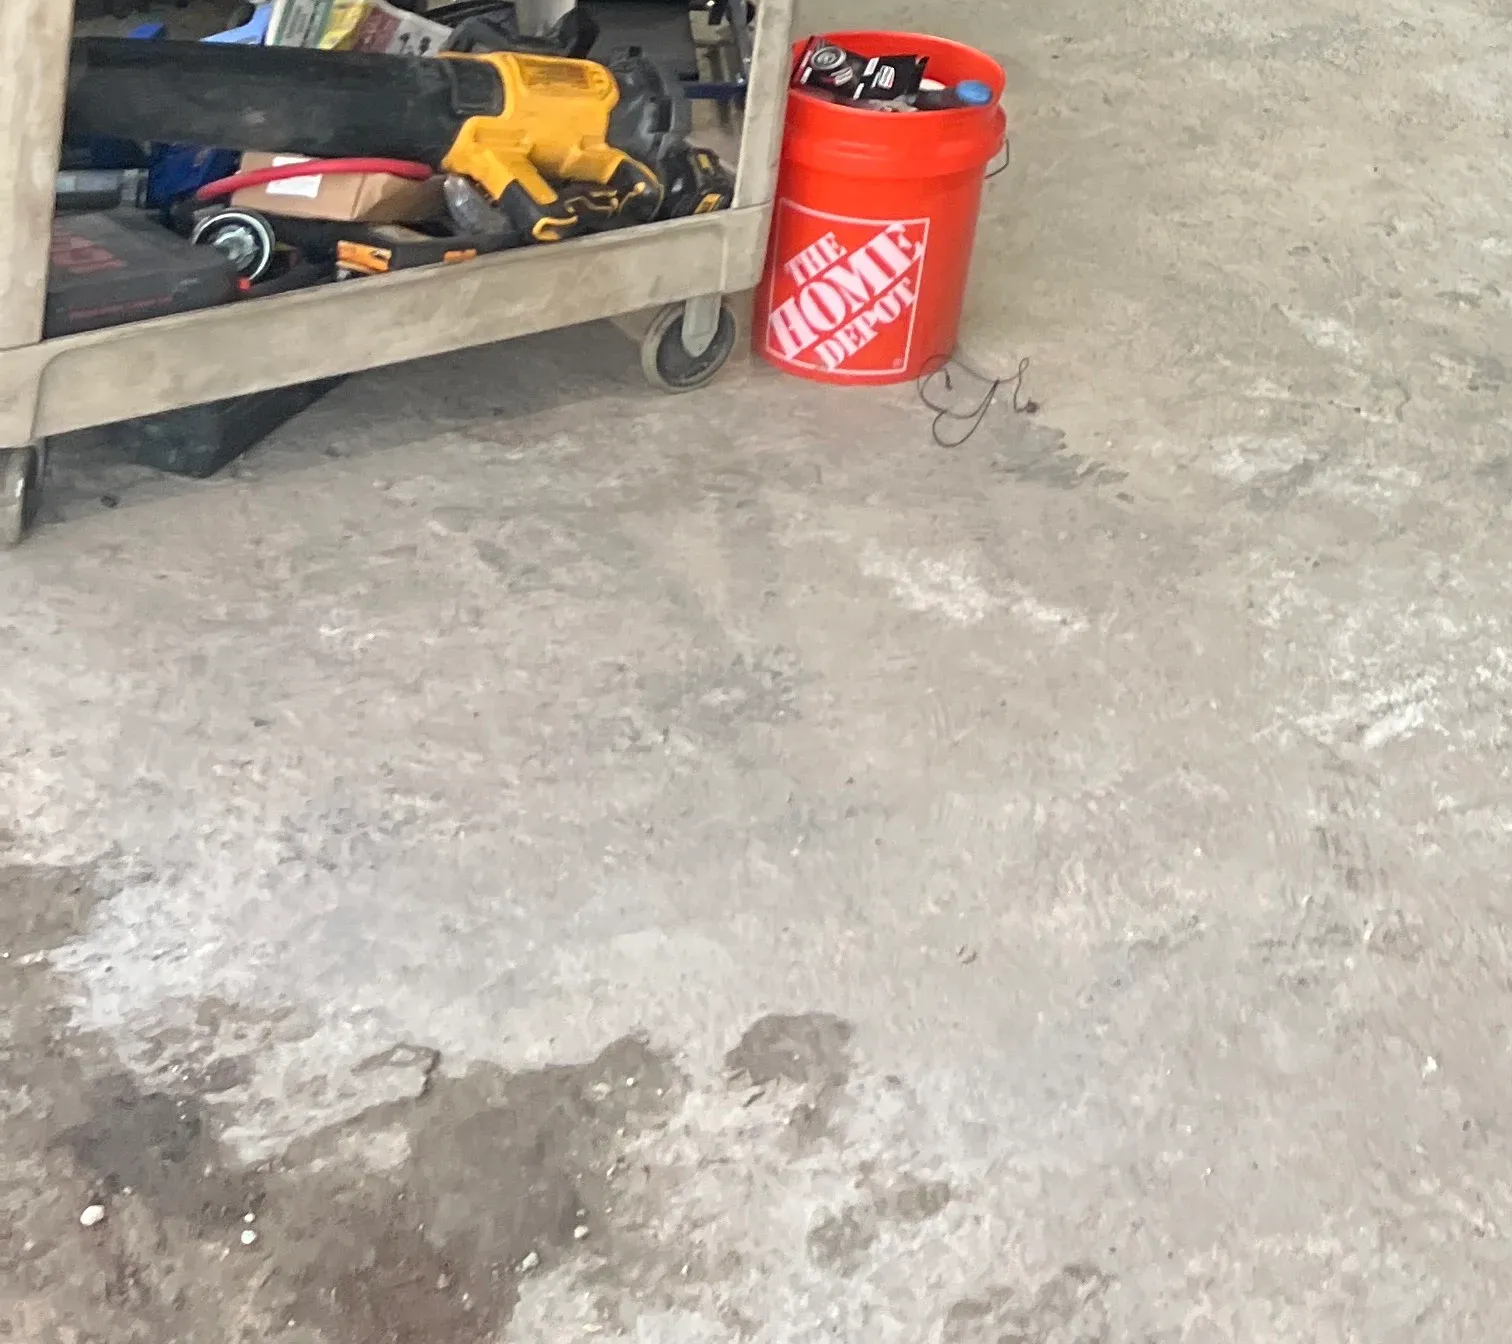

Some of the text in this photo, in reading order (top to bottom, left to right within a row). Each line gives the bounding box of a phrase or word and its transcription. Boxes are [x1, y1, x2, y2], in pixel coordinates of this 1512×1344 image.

[769, 223, 923, 360] HOME
[783, 230, 849, 286] THE
[814, 276, 916, 372] DEPOT
